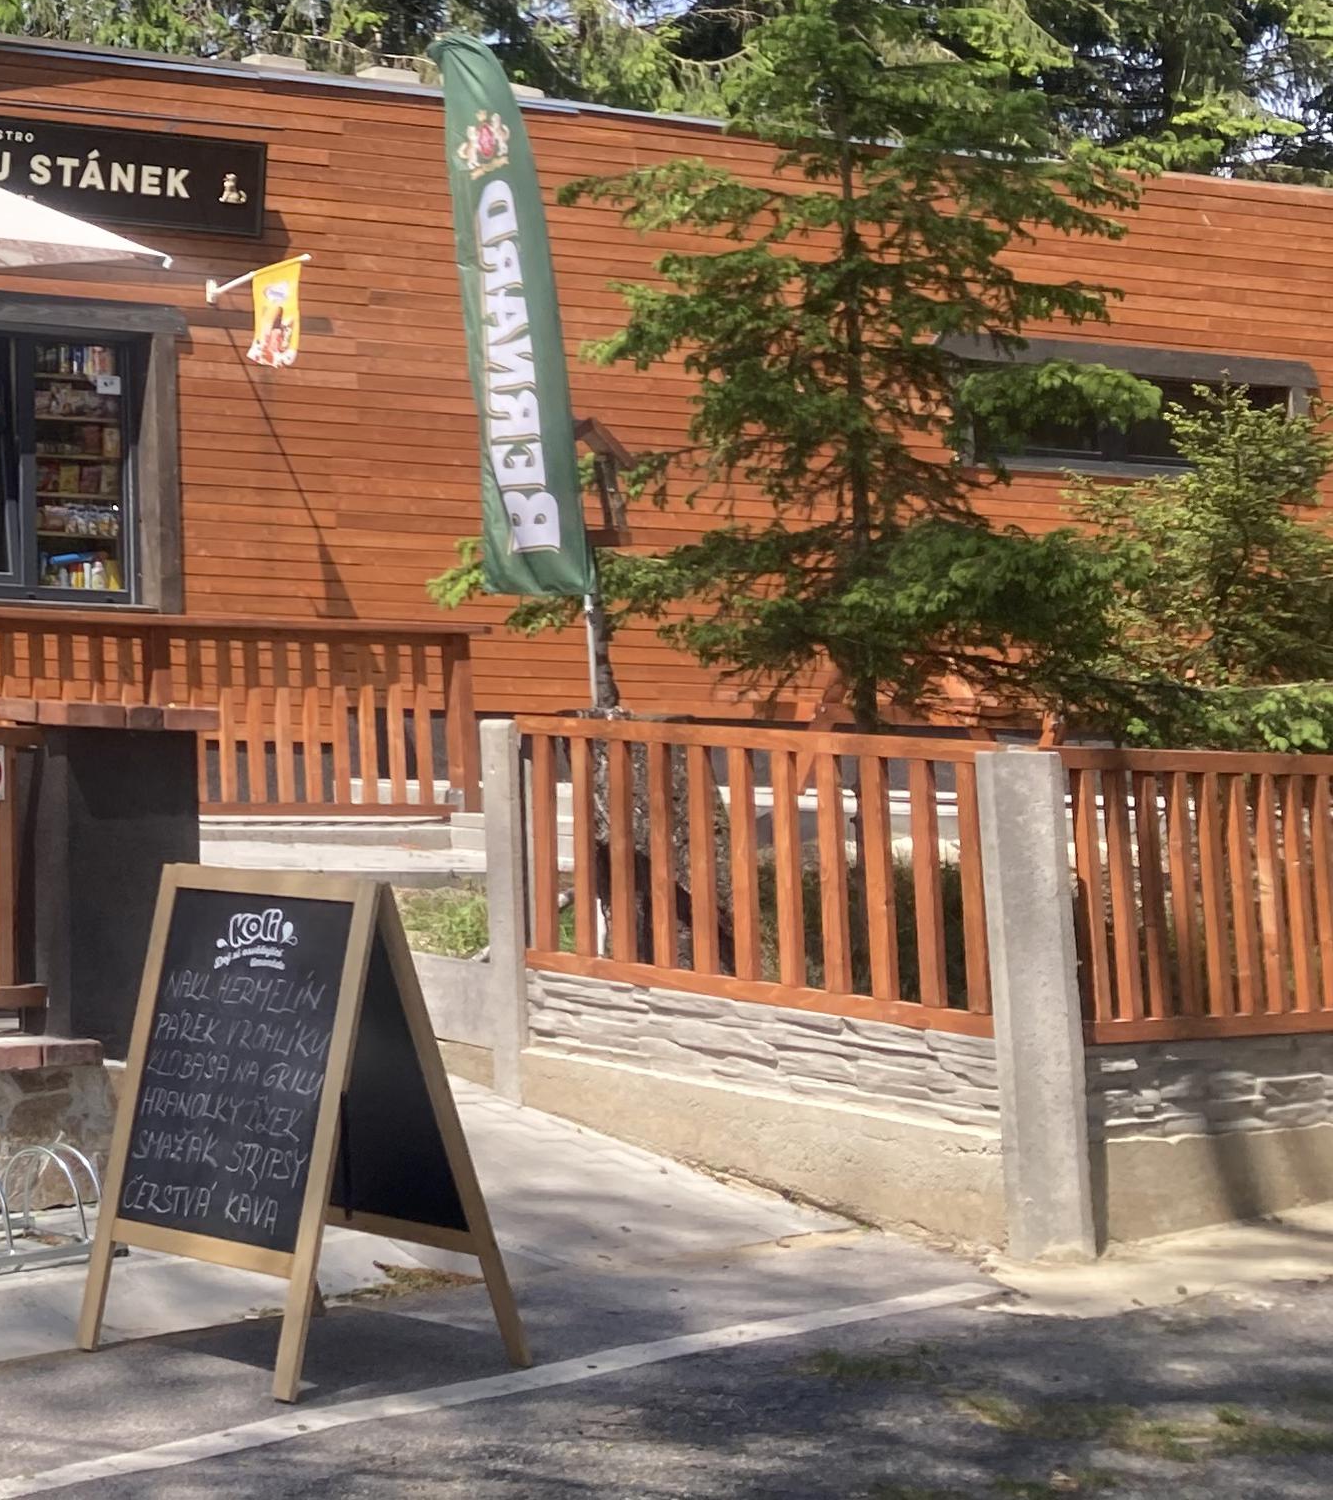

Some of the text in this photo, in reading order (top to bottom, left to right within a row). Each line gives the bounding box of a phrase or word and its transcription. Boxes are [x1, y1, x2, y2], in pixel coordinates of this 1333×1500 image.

[29, 149, 190, 199] STÁNEK
[474, 179, 561, 555] BERNARD
[218, 970, 326, 1013] HERMELÍN
[154, 1008, 221, 1045] PÁREK
[146, 1050, 230, 1084] KLOBÁSA
[232, 1059, 260, 1086] NA
[140, 1086, 245, 1126] HRANOLKY
[132, 1127, 309, 1189] SMAŽÁK STRIPSY
[123, 1174, 218, 1219] ČERSTVÁ
